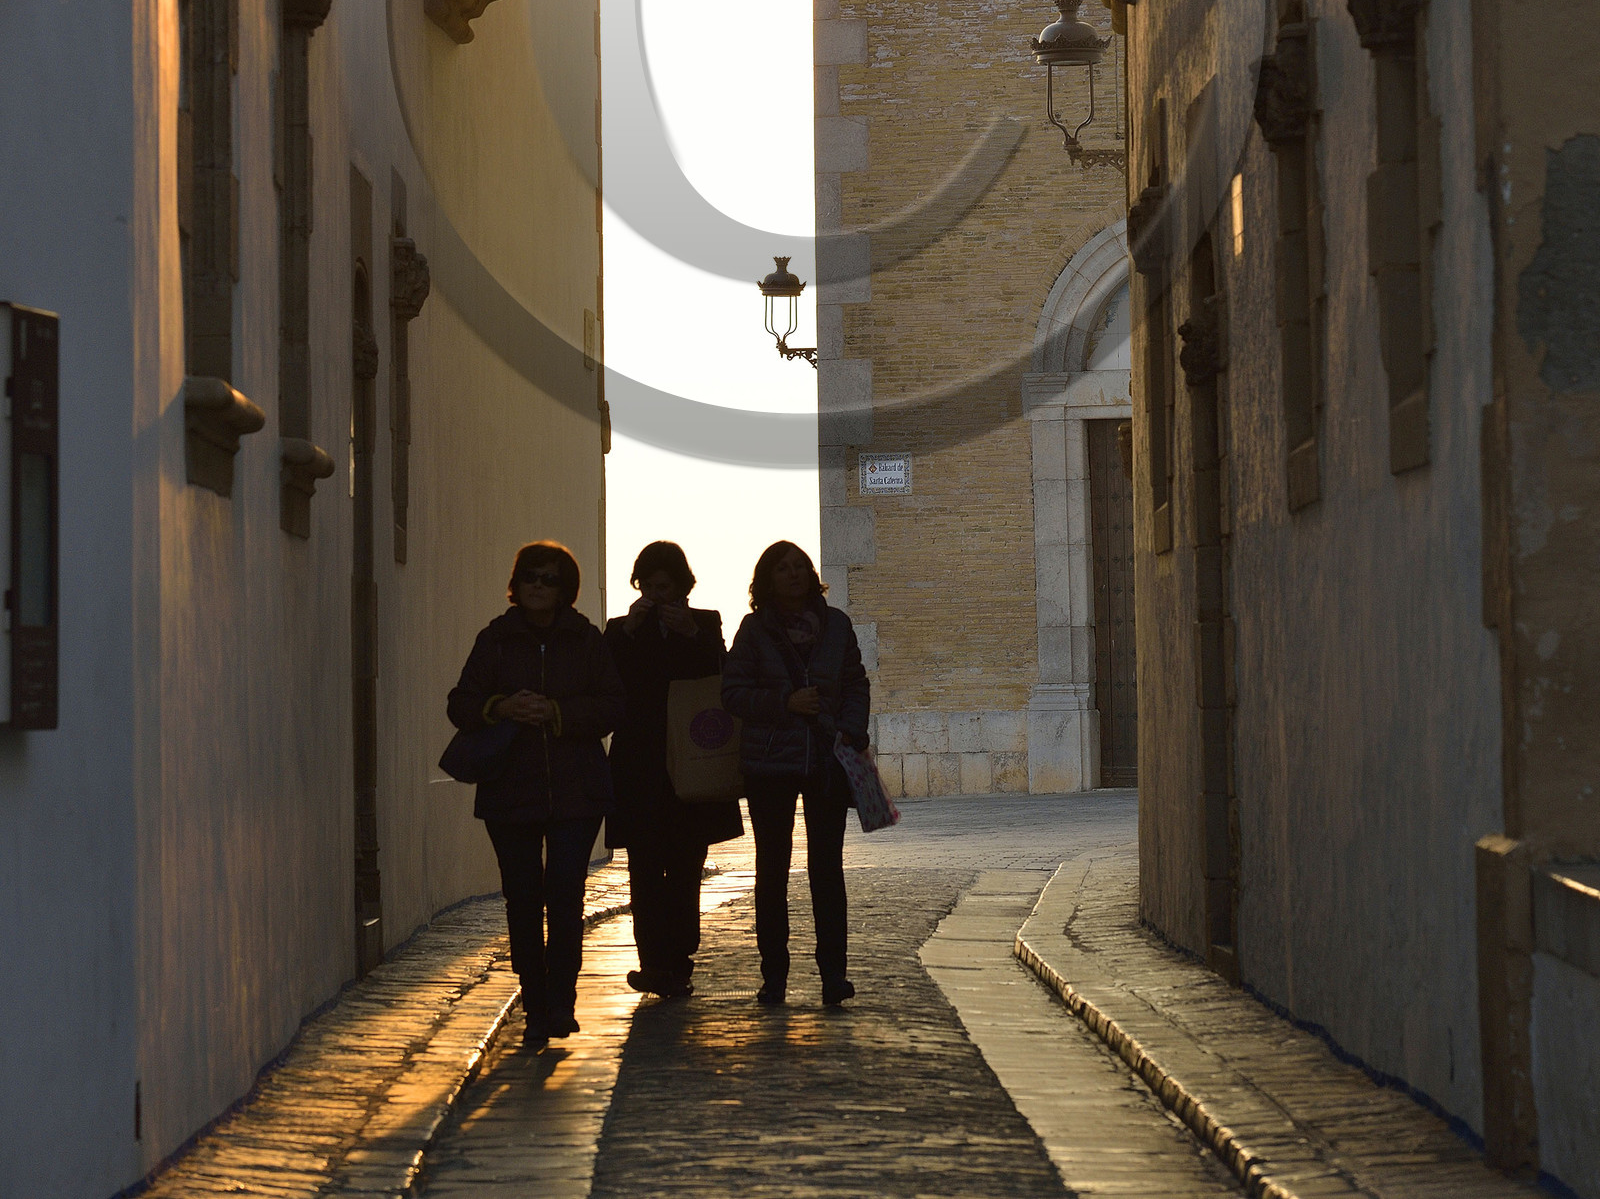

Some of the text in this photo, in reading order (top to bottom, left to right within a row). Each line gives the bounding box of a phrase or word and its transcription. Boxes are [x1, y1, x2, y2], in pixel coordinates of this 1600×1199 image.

[897, 463, 903, 471] de
[869, 476, 903, 485] Santa Caterina
